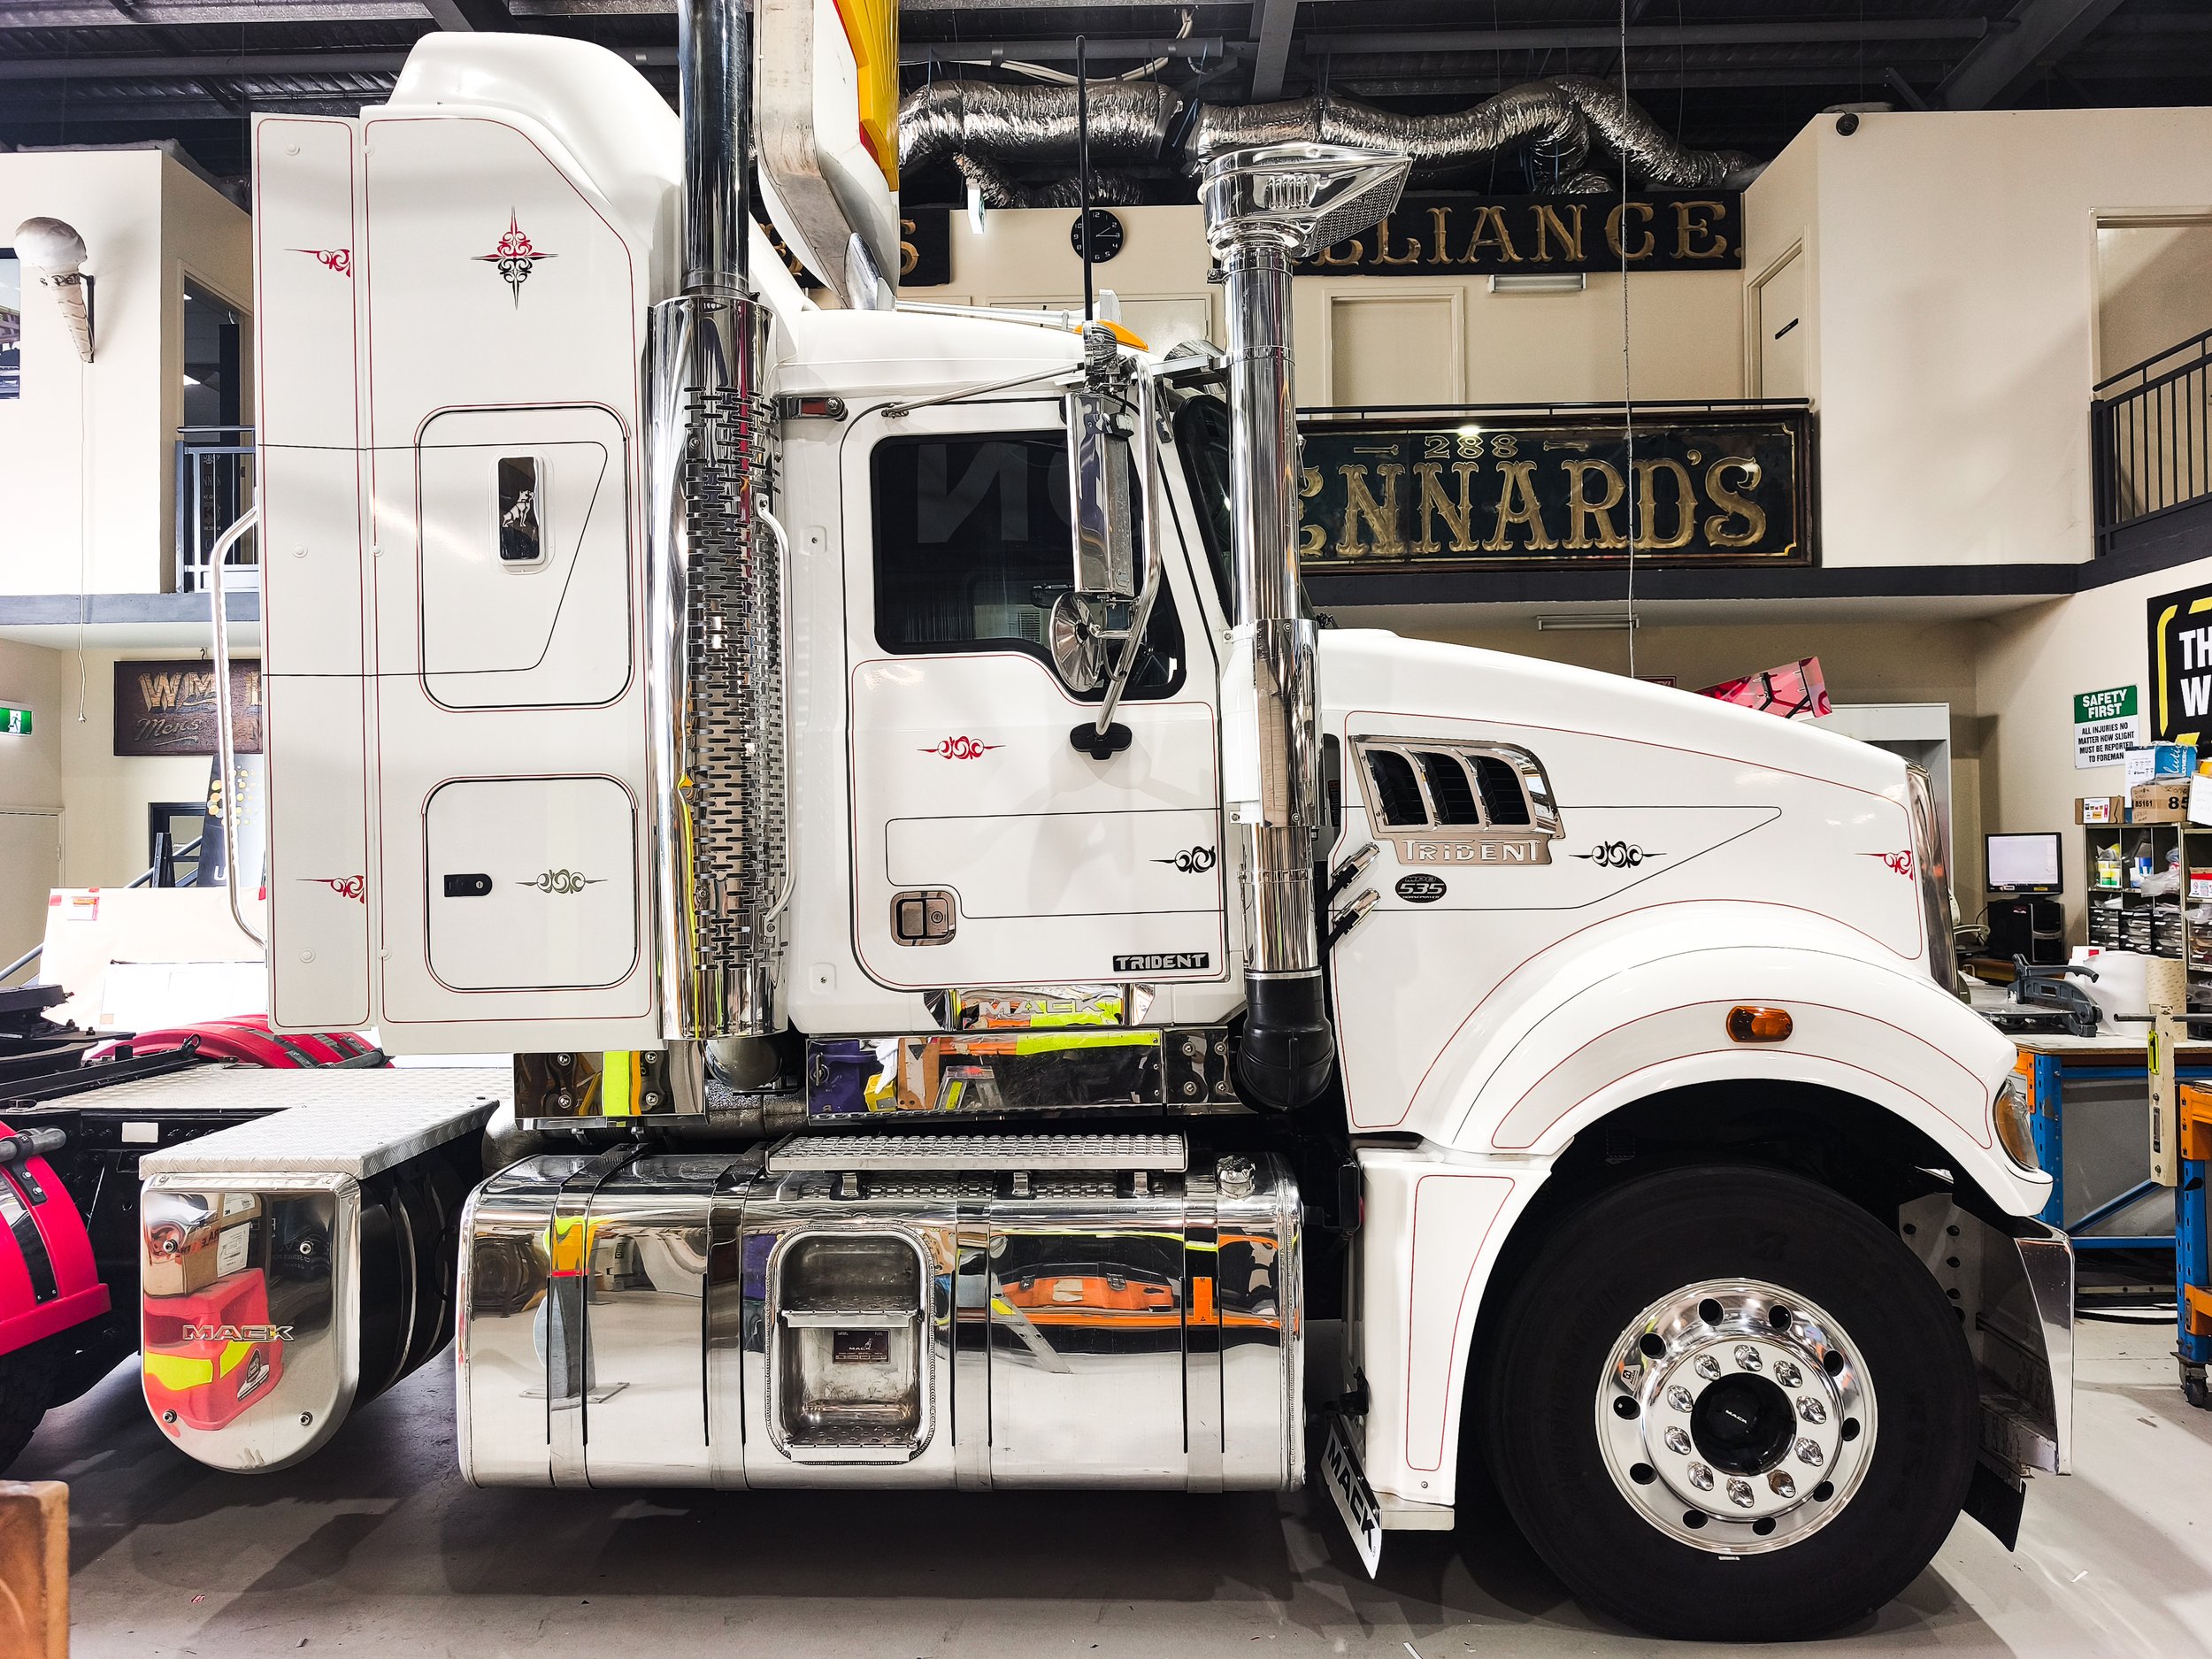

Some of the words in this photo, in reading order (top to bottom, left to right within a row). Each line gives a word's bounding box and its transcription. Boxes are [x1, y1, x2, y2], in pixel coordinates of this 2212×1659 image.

[1310, 201, 1743, 265] LIANCE.
[1424, 434, 1519, 459] 288
[2082, 688, 2127, 708] SAFETY
[2088, 703, 2122, 719] FIRST
[2081, 726, 2091, 735] ALL
[2093, 723, 2118, 733] INJURIES
[2078, 735, 2099, 745] MATTER
[2101, 733, 2113, 742] HOW
[2115, 731, 2134, 741] SLIGHT
[2079, 745, 2094, 755] MUST
[2096, 744, 2103, 753] BE
[2105, 741, 2133, 752] REPORTED
[2096, 752, 2124, 762] FOREMAN
[1402, 839, 1541, 861] TRIDENT
[1398, 883, 1445, 895] 535
[1115, 953, 1207, 970] TRIDENT
[979, 999, 1106, 1016] MACK
[182, 1325, 295, 1342] MACK
[1327, 1436, 1375, 1553] MACK
